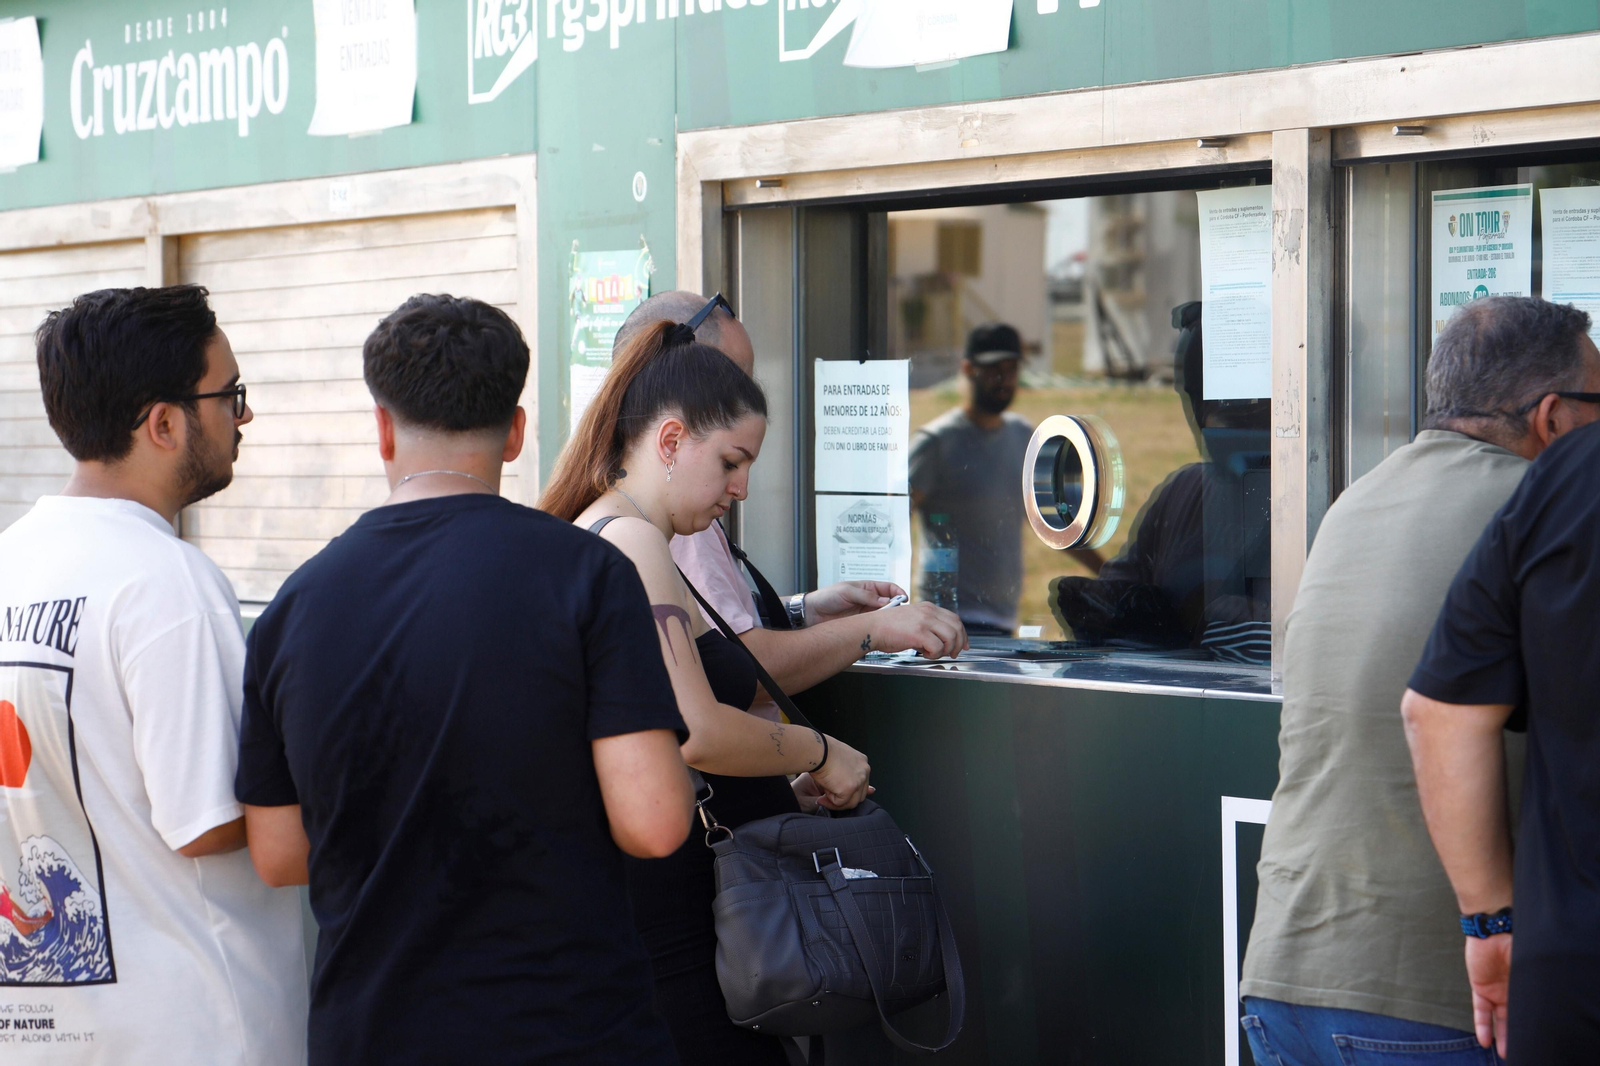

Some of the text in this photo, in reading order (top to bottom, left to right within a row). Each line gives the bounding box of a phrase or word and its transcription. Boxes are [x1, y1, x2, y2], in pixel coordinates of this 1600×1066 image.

[125, 16, 173, 44] DESDE
[340, 39, 391, 72] ENTRADAS
[70, 38, 290, 140] Cruzcampo
[1459, 210, 1500, 238] ON TOUR
[823, 384, 891, 396] PARA ENTRADAS DE
[823, 402, 902, 417] MENORES DE 12 AÑOS:
[823, 426, 893, 436] DEBEN ACREDITAR LA EDAD
[823, 441, 899, 452] CON DNI O LIBRO DE FAMILIA
[847, 513, 877, 524] NORMAS
[0, 596, 87, 658] NATURE
[18, 1004, 54, 1014] FOLLOW
[14, 1019, 55, 1030] NATURE
[21, 1033, 52, 1043] ALONG
[55, 1032, 80, 1042] WITH
